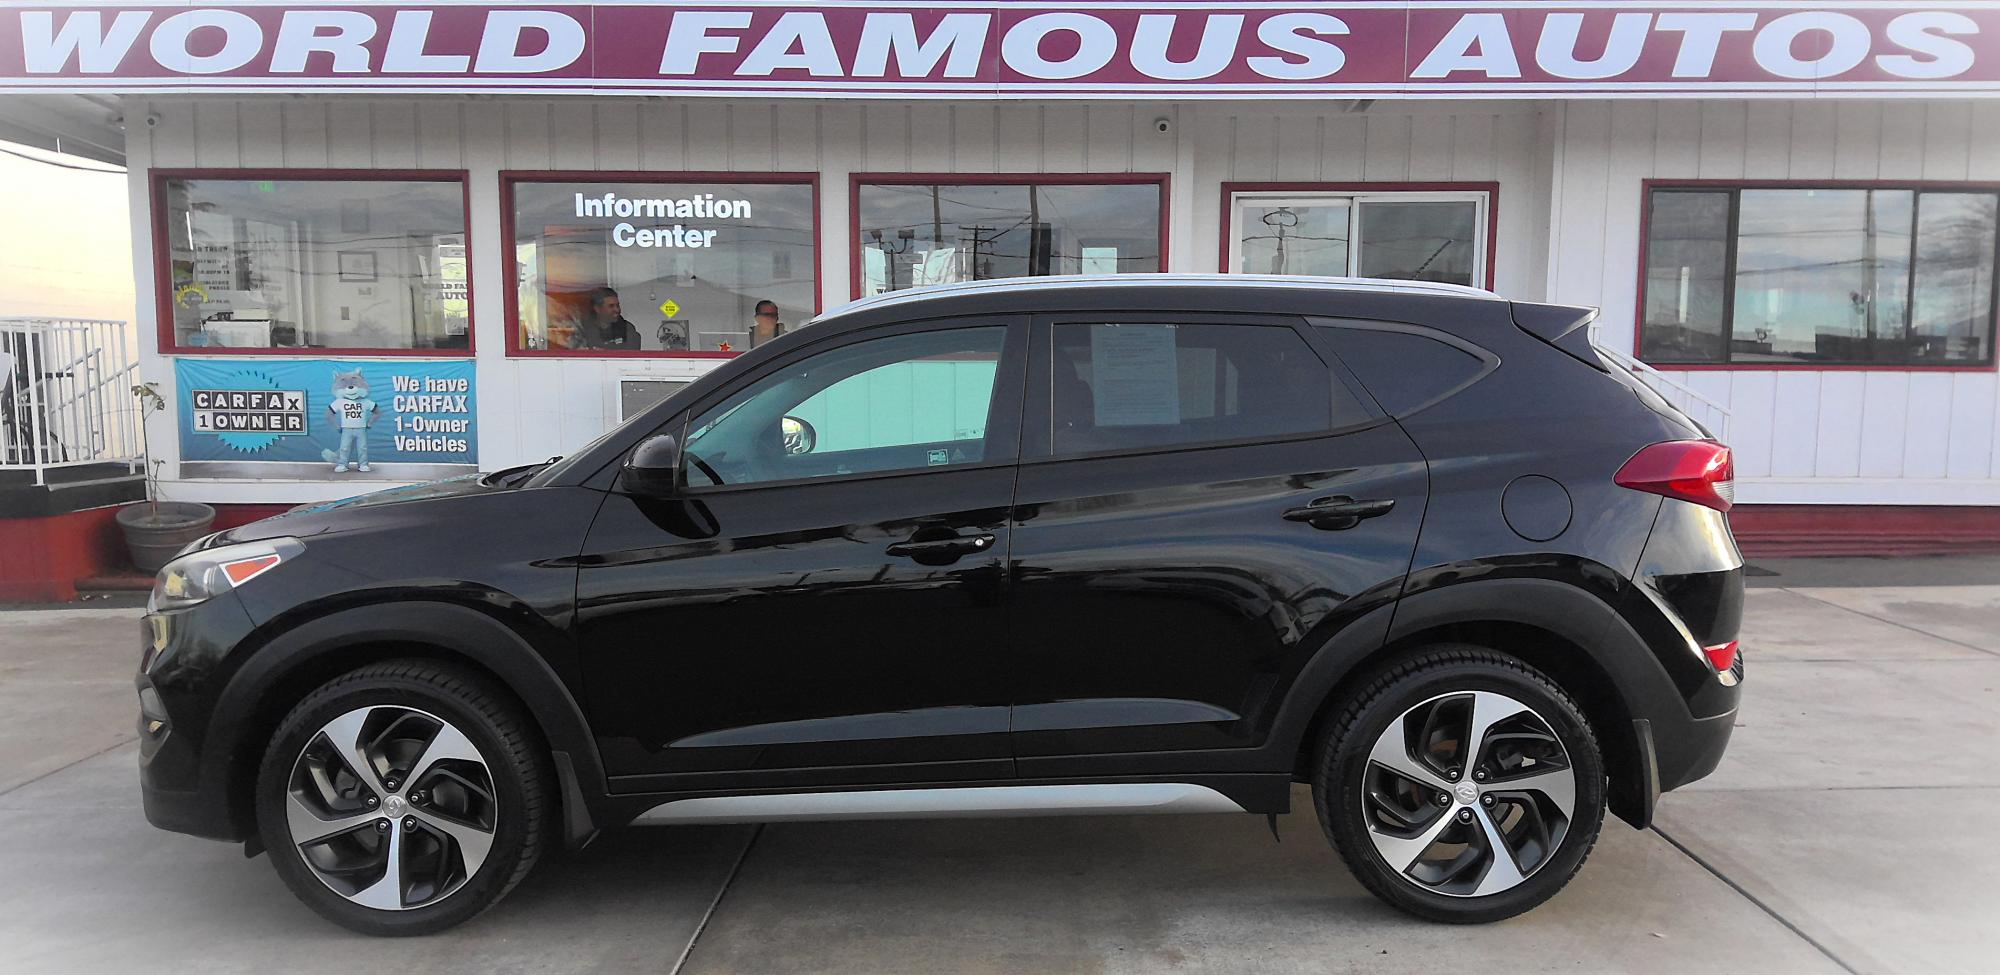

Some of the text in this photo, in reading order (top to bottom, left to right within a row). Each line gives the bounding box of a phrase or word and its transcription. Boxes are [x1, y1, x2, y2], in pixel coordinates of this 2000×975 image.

[20, 10, 1981, 80] WORLD FAMOUS AUTOS
[575, 193, 752, 218] Information
[613, 222, 717, 248] Center
[392, 375, 468, 392] We have
[196, 393, 300, 410] CARFAX
[343, 403, 362, 411] CAR
[393, 395, 468, 413] CARFAX
[199, 414, 301, 429] 1 OWNER
[345, 411, 362, 419] FOX
[394, 416, 469, 433] 1-Owner
[394, 435, 467, 452] Vehicles
